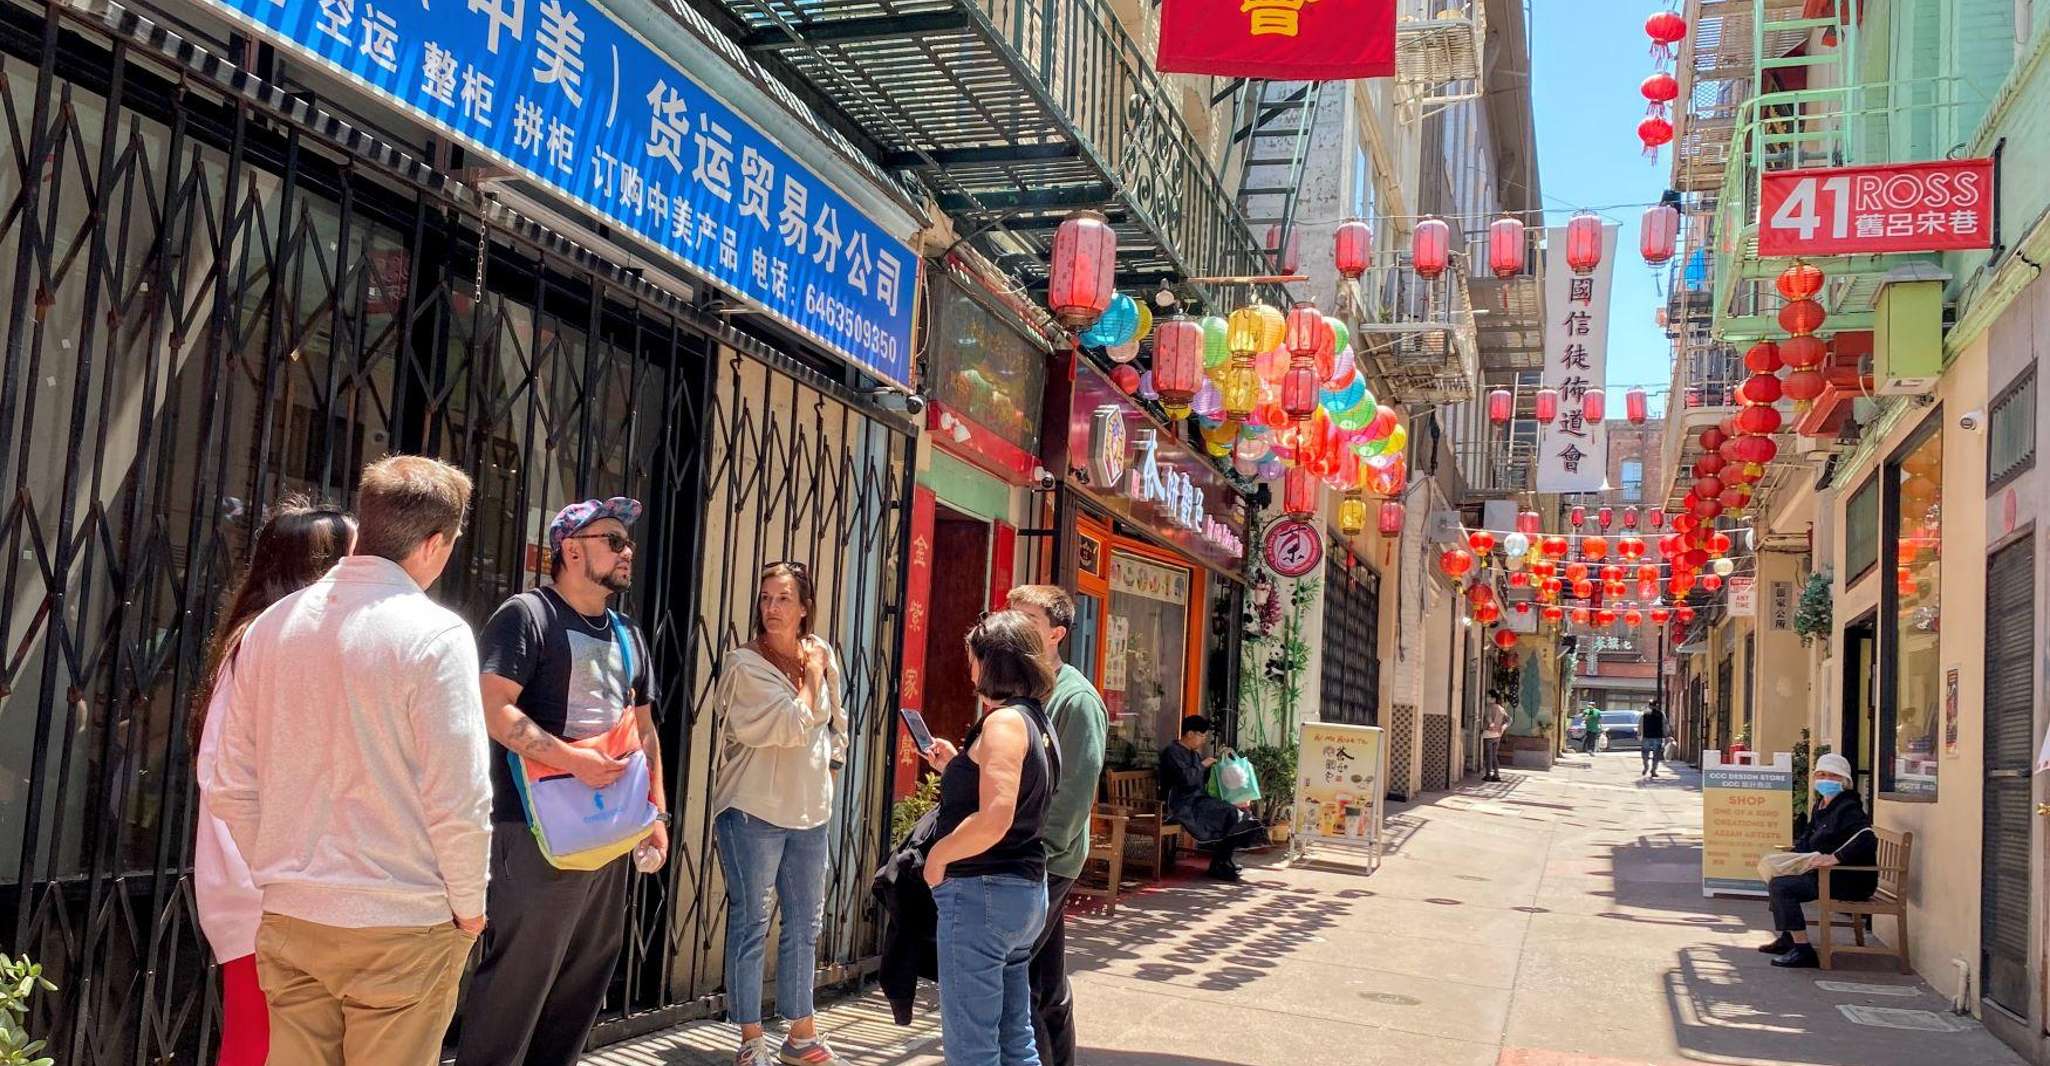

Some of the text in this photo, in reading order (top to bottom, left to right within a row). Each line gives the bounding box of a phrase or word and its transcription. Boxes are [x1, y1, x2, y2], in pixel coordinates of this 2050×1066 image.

[421, 41, 494, 128] 整柜
[513, 96, 575, 175] 拼柜
[592, 145, 739, 273] 订购中美产品
[805, 283, 897, 364] 6463509350
[1770, 170, 1979, 240] 41 ROSS
[1855, 209, 1979, 239] 舊呂宋巷
[1728, 795, 1766, 806] SHOP
